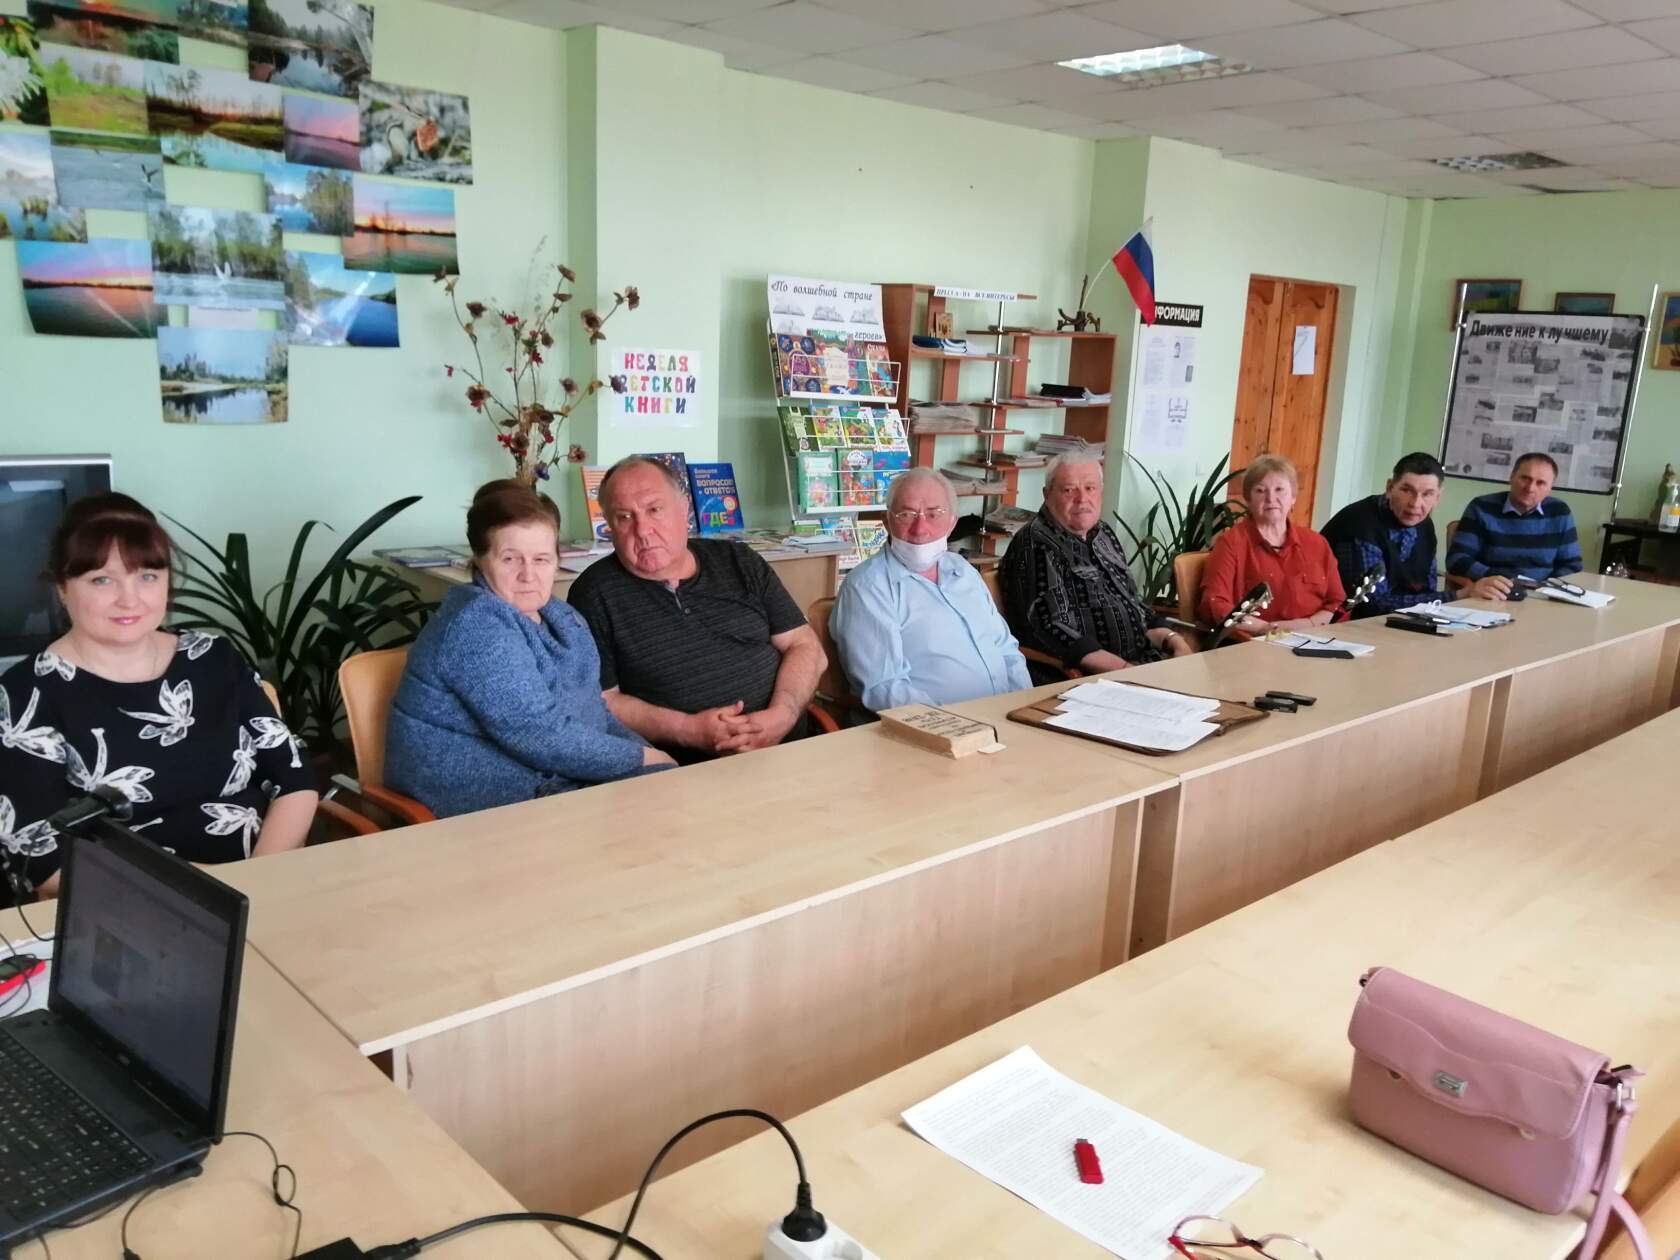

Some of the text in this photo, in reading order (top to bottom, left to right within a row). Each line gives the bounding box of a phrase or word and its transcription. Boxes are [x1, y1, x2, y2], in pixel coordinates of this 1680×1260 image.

[771, 280, 873, 303] «По волшебной стране
[1155, 305, 1200, 324] ФОРМАЦИЯ
[1538, 328, 1546, 339] к
[624, 352, 689, 372] НЕДЕЛЯ
[624, 396, 687, 414] КНИГИ
